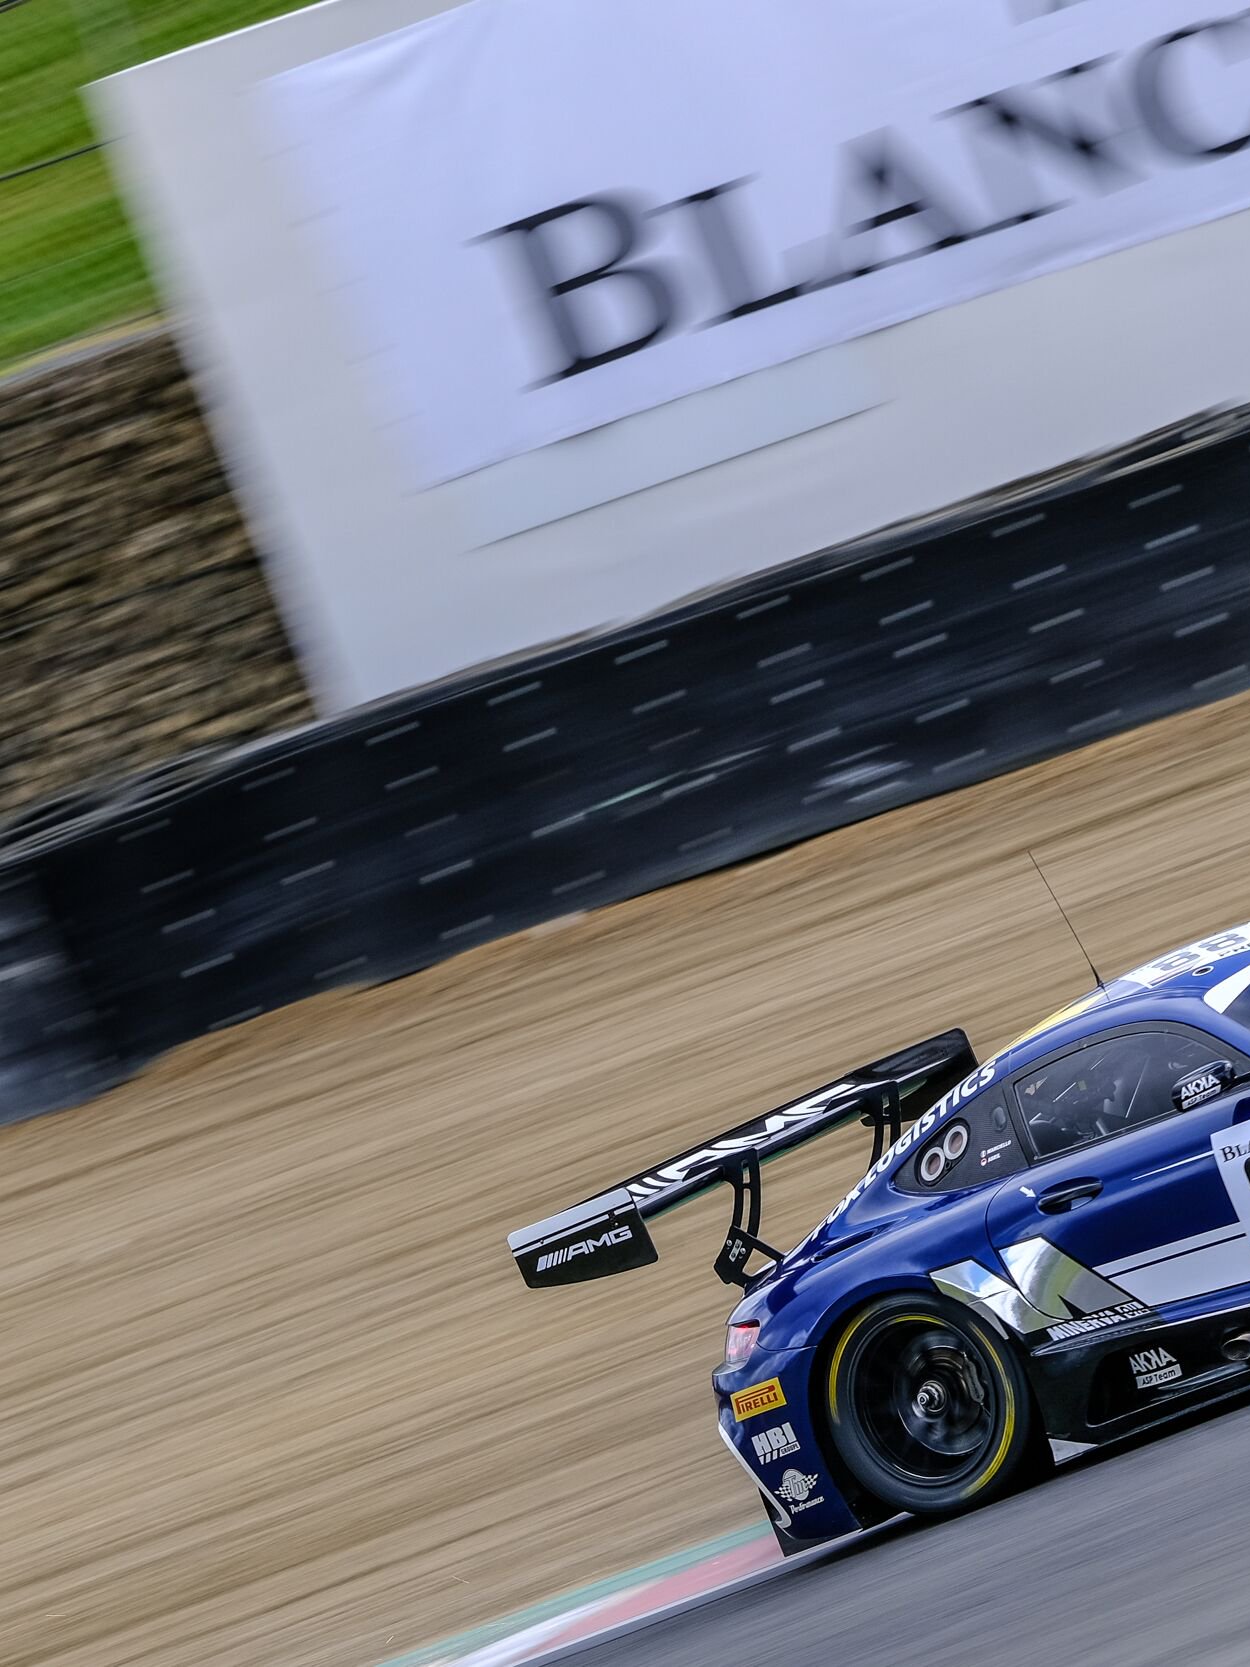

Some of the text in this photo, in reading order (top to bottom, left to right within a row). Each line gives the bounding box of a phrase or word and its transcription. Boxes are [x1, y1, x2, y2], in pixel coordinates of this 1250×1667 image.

[1180, 1073, 1221, 1100] AKKA
[863, 1060, 996, 1189] LOGISTICS
[1129, 1347, 1177, 1374] AKKA
[1155, 1369, 1177, 1382] Team
[735, 1385, 779, 1415] PIRELLI
[752, 1422, 798, 1457] HBI
